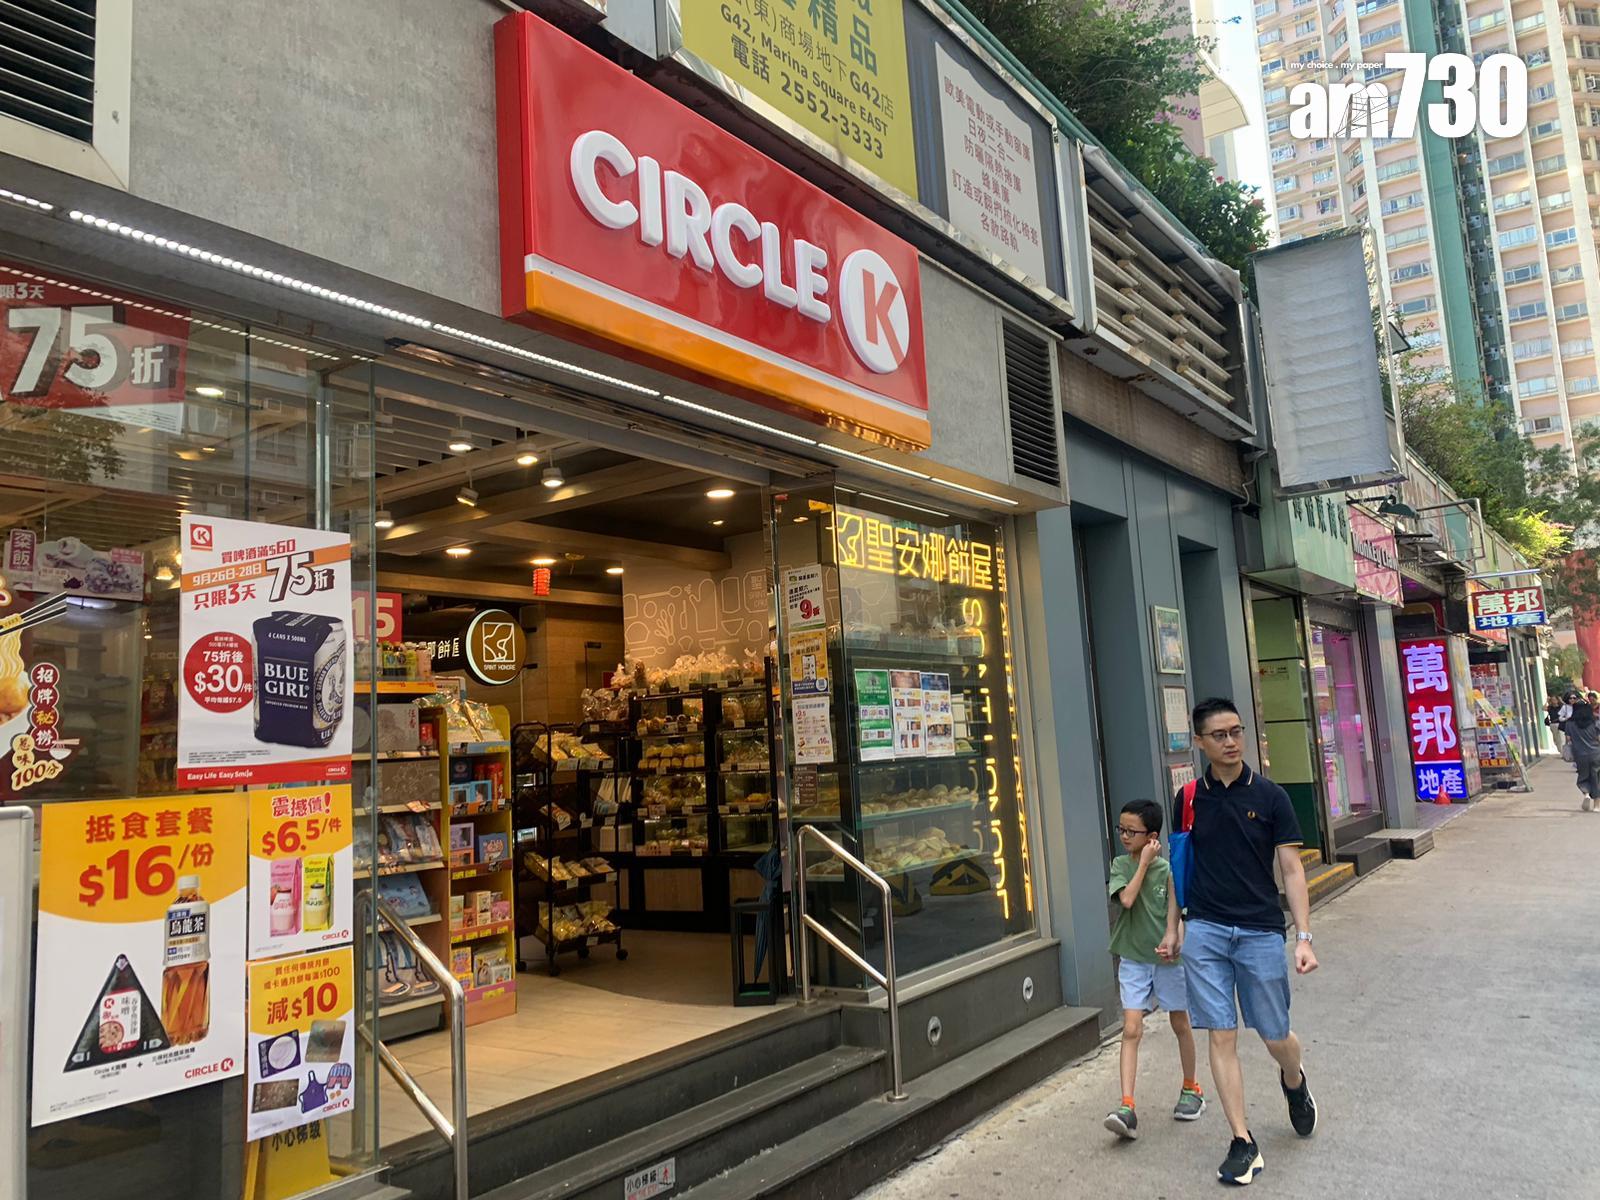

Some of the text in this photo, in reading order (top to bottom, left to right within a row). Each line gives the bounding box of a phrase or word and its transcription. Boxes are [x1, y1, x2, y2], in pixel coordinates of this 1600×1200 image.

[721, 4, 888, 136] G42, Marina Square EAST
[735, 0, 894, 120] (東)商場地下G42店
[731, 33, 884, 159] 電話 2552-3333
[968, 117, 1015, 162] 日夜二合一
[570, 130, 832, 323] CIRCLE
[8, 306, 165, 394] 75折
[221, 539, 296, 564] 買啤酒滿$60
[865, 518, 994, 590] 聖安娜餅屋
[192, 563, 262, 586] 9月26日-28日
[266, 551, 334, 602] 75折
[193, 583, 256, 610] 只限3天
[1475, 589, 1540, 616] 萬邦
[1479, 612, 1542, 627] 地產
[203, 650, 244, 664] 75折後
[264, 663, 309, 682] BLUE
[194, 664, 253, 693] $30/件
[1403, 643, 1457, 756] 萬邦
[187, 769, 253, 781] Easy Life Easy Smile
[1418, 768, 1463, 796] 地產
[272, 792, 332, 817] 震撼價!
[86, 807, 213, 844] 抵食套餐
[262, 817, 342, 856] $6.5/件
[79, 843, 214, 907] $16/份
[171, 916, 204, 935] 烏龍茶
[267, 982, 338, 1025] 減$10
[185, 1057, 234, 1078] CIRCLE K
